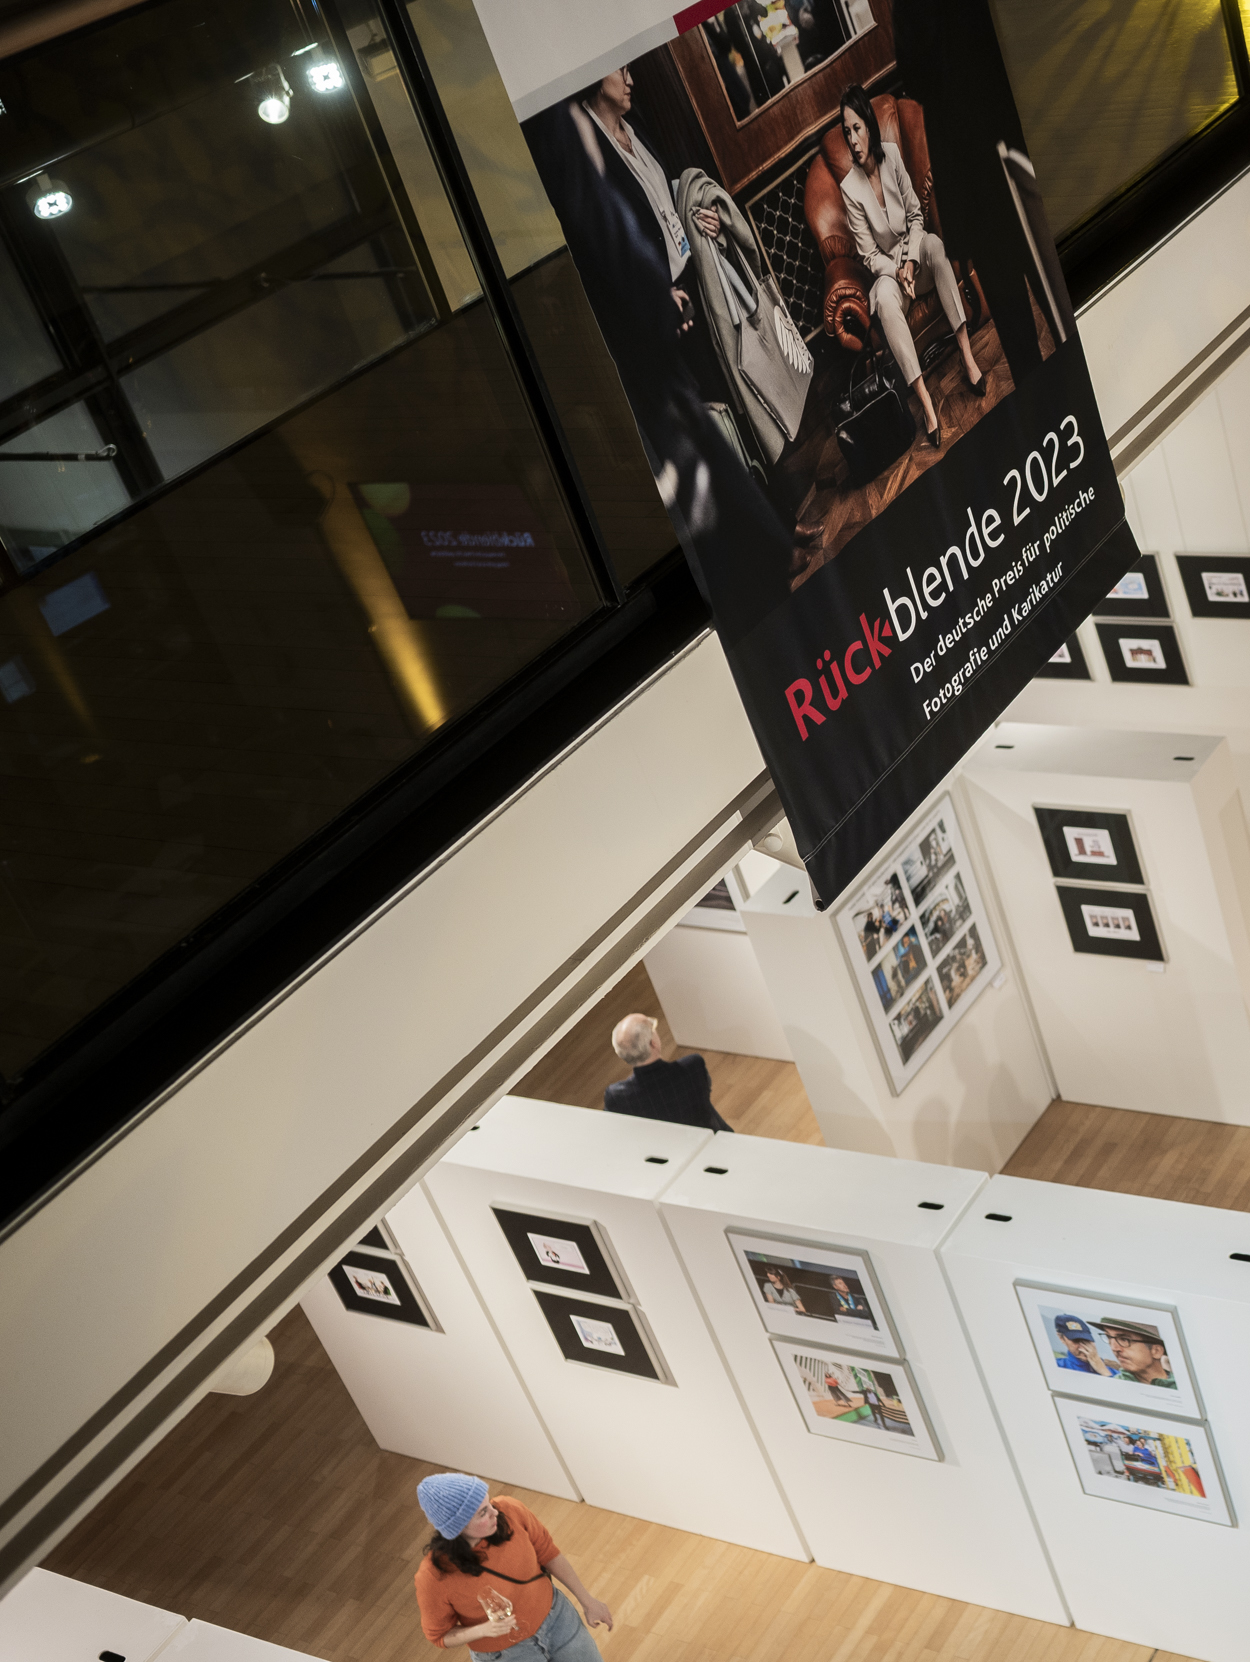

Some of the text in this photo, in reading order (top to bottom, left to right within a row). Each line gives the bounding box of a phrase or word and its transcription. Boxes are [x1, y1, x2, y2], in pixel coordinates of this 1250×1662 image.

[1003, 414, 1085, 527] 2023
[909, 485, 1096, 684] Der deutsche Preis für politische
[922, 561, 1065, 721] Fotografie und Karikatur
